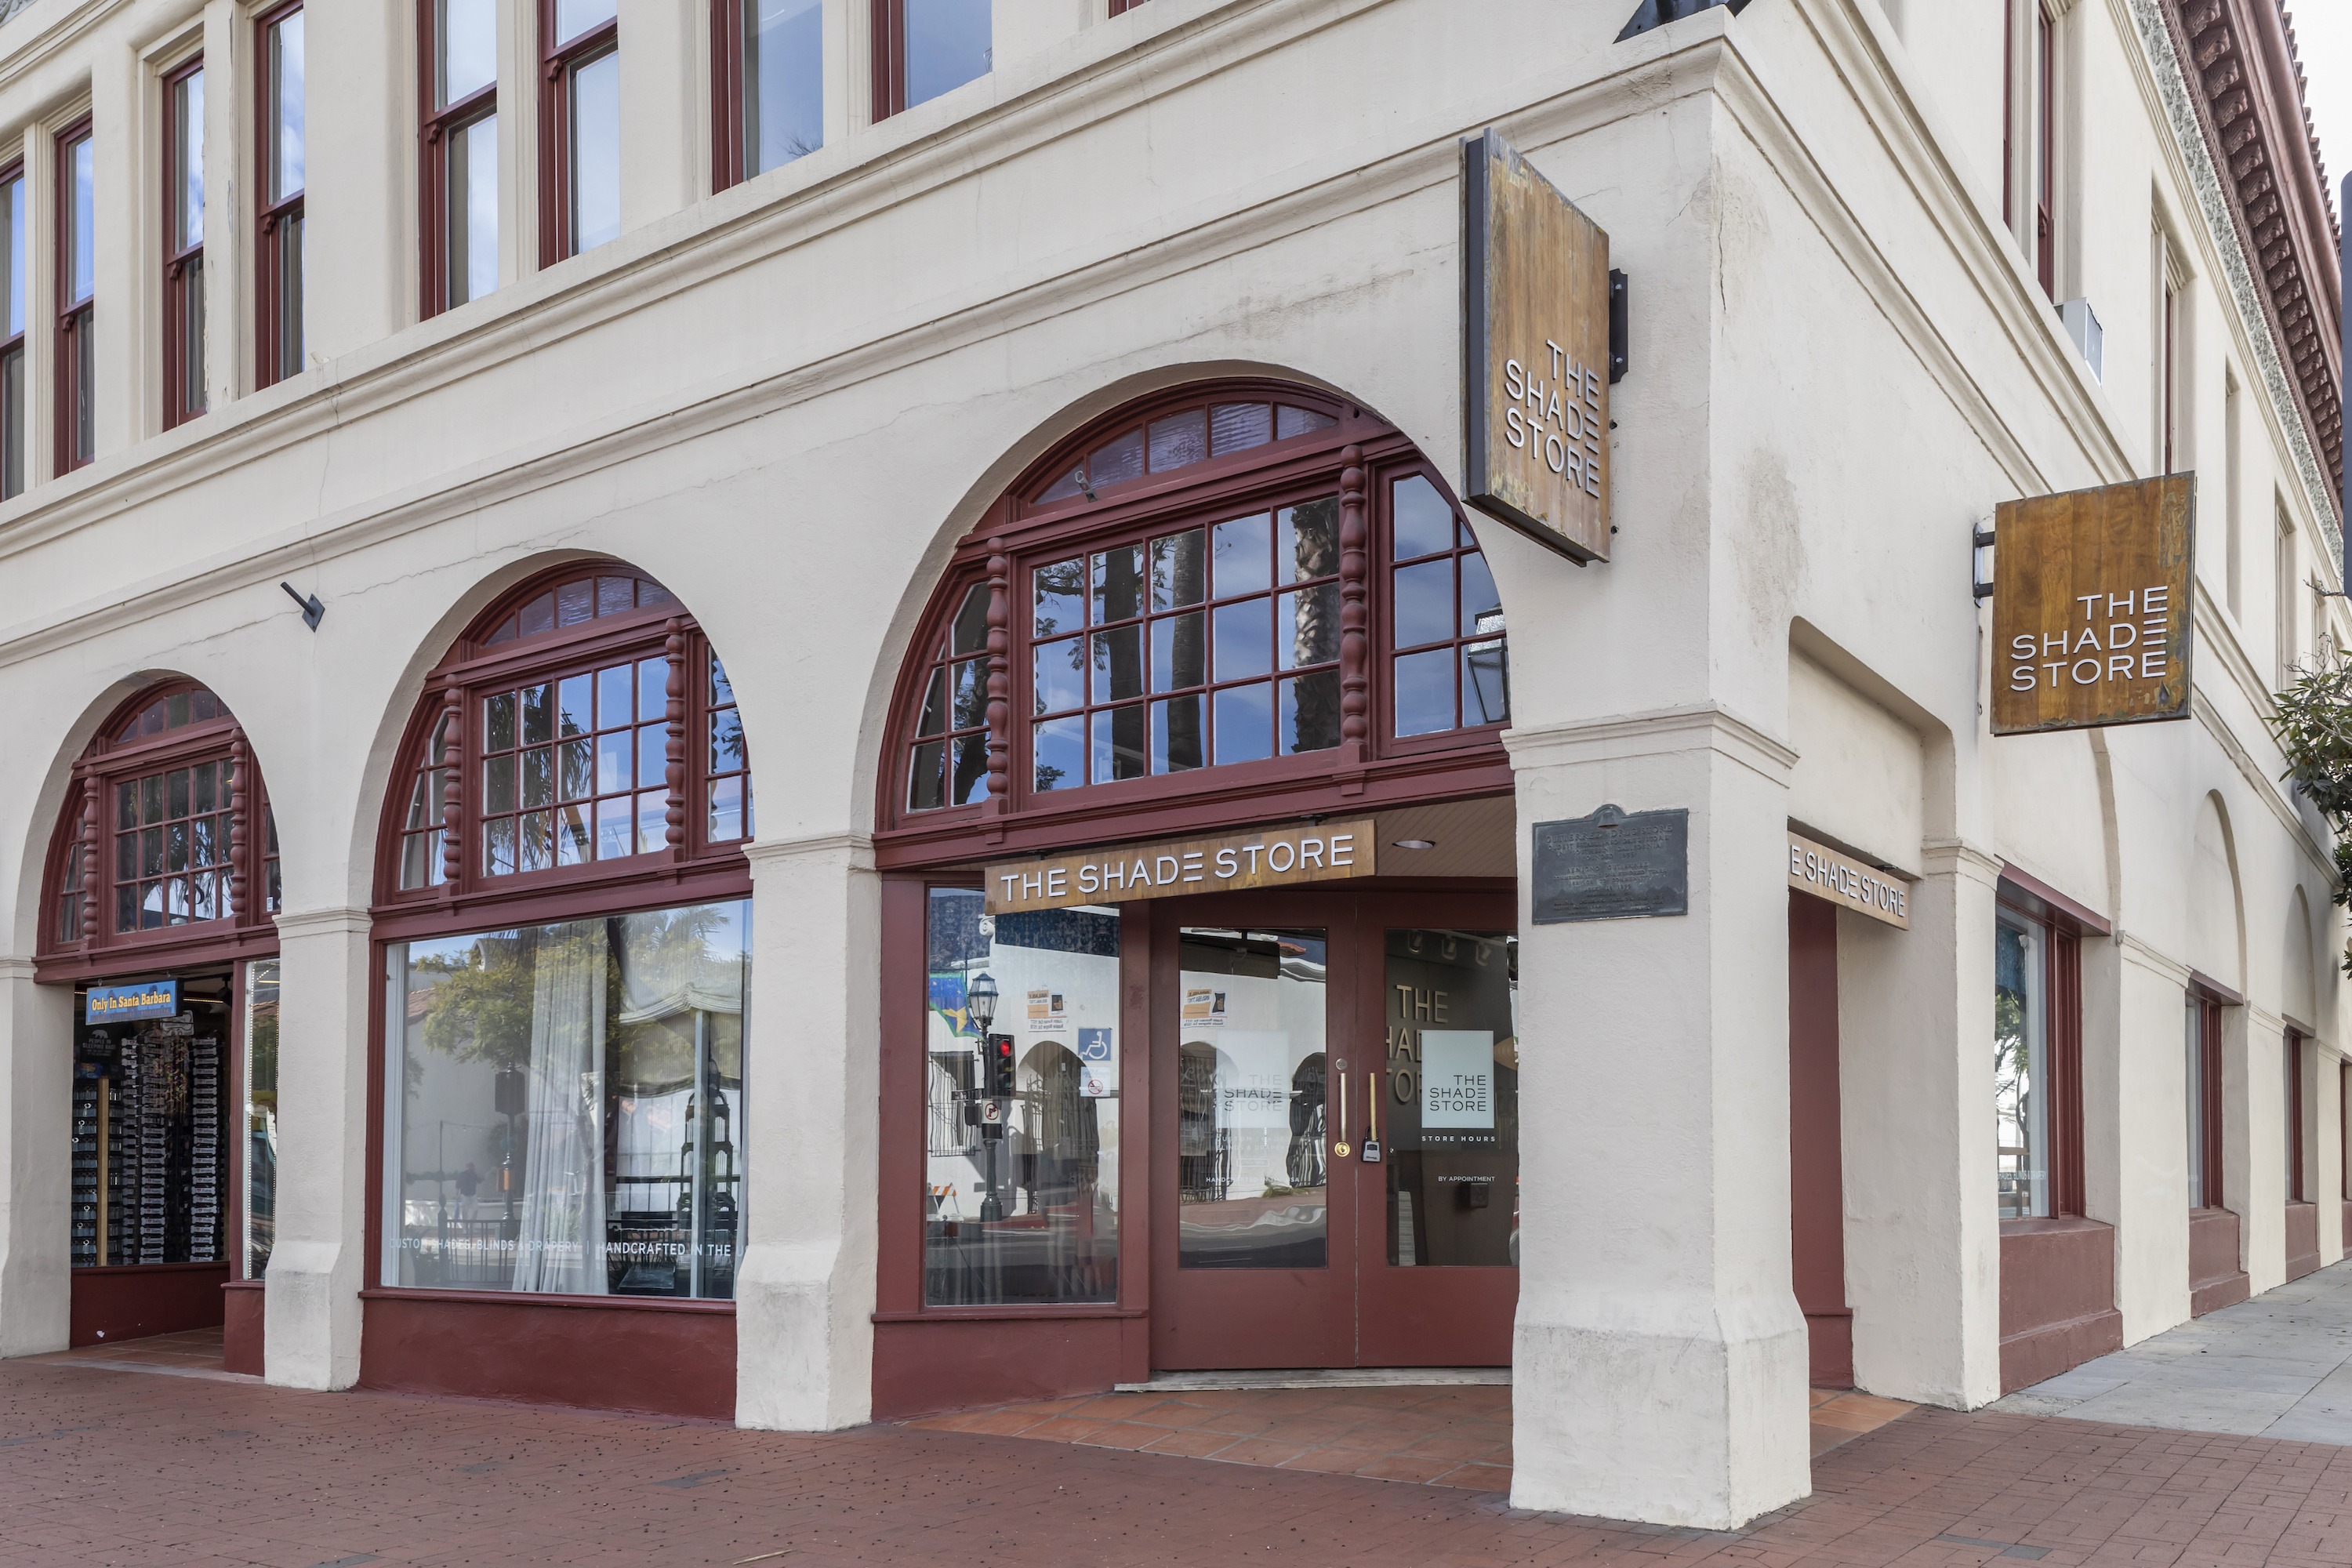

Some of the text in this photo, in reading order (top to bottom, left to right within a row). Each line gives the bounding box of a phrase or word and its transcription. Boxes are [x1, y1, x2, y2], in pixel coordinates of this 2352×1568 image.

[1546, 339, 1599, 411] THE
[1505, 358, 1599, 455] SHADE
[1505, 407, 1600, 499] STORE
[2077, 586, 2169, 621] THE
[2011, 618, 2167, 660] SHADE
[2010, 650, 2166, 691] STORE
[1546, 824, 1673, 844] GUTIERREZ DRUG STORE
[1000, 835, 1354, 902] THE SHADE STORE
[1607, 862, 1649, 870] GUTIERREZ
[1805, 851, 1858, 898] SHADE
[1860, 875, 1905, 917] STORE
[92, 991, 171, 1013] Only In Santa Barbara
[1396, 985, 1449, 1023] THE
[1248, 1074, 1282, 1085] THE
[1454, 1075, 1486, 1085] THE
[1225, 1087, 1282, 1098] SHADE
[1429, 1087, 1486, 1098] SHADE
[1225, 1100, 1282, 1112] STORE
[1429, 1101, 1486, 1112] STORE
[389, 1238, 427, 1249] CUSTOM
[477, 1240, 514, 1250] BLINDS
[517, 1241, 524, 1251] &
[528, 1240, 579, 1253] DRAPERY
[598, 1241, 686, 1255] HANDCRAFTED
[691, 1243, 702, 1256] IN
[707, 1244, 731, 1257] THE
